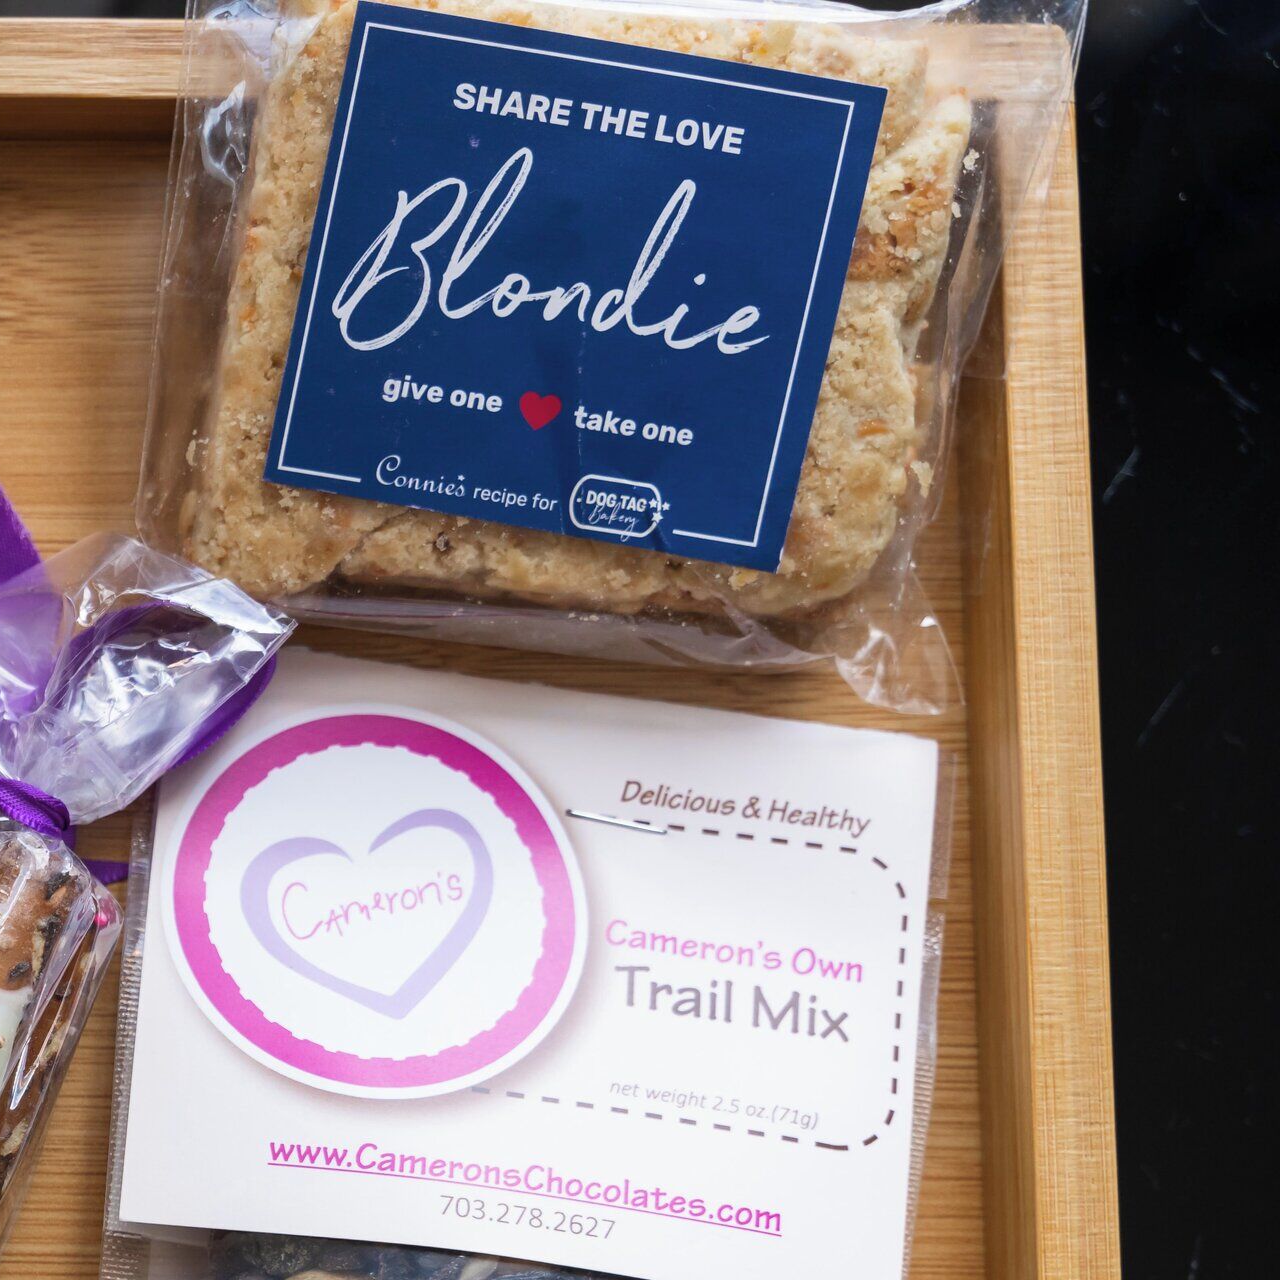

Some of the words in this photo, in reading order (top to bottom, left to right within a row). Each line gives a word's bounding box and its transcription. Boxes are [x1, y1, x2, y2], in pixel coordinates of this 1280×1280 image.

[452, 82, 573, 127] SHARE
[579, 101, 650, 140] THE
[654, 115, 746, 155] LOVE
[331, 146, 771, 354] Blondie
[382, 374, 444, 405] give
[450, 388, 503, 412] one
[573, 404, 636, 437] take
[642, 420, 695, 446] one
[472, 485, 527, 508] recipe
[531, 492, 558, 511] for
[585, 490, 617, 508] DOG
[617, 494, 648, 512] TAG
[589, 504, 640, 542] Bakery
[620, 779, 736, 818] Delicious
[741, 796, 762, 818] &
[767, 800, 871, 837] Healthy
[604, 919, 782, 973] Cameron's
[791, 947, 864, 984] Own
[614, 965, 734, 1024] Trail
[751, 985, 850, 1043] Mix
[610, 1081, 640, 1098] net
[645, 1088, 707, 1109] weight
[712, 1096, 741, 1114] 2.5
[268, 1140, 782, 1232] www.CameronsChocolates.com
[439, 1194, 617, 1240] 703.278.2627
